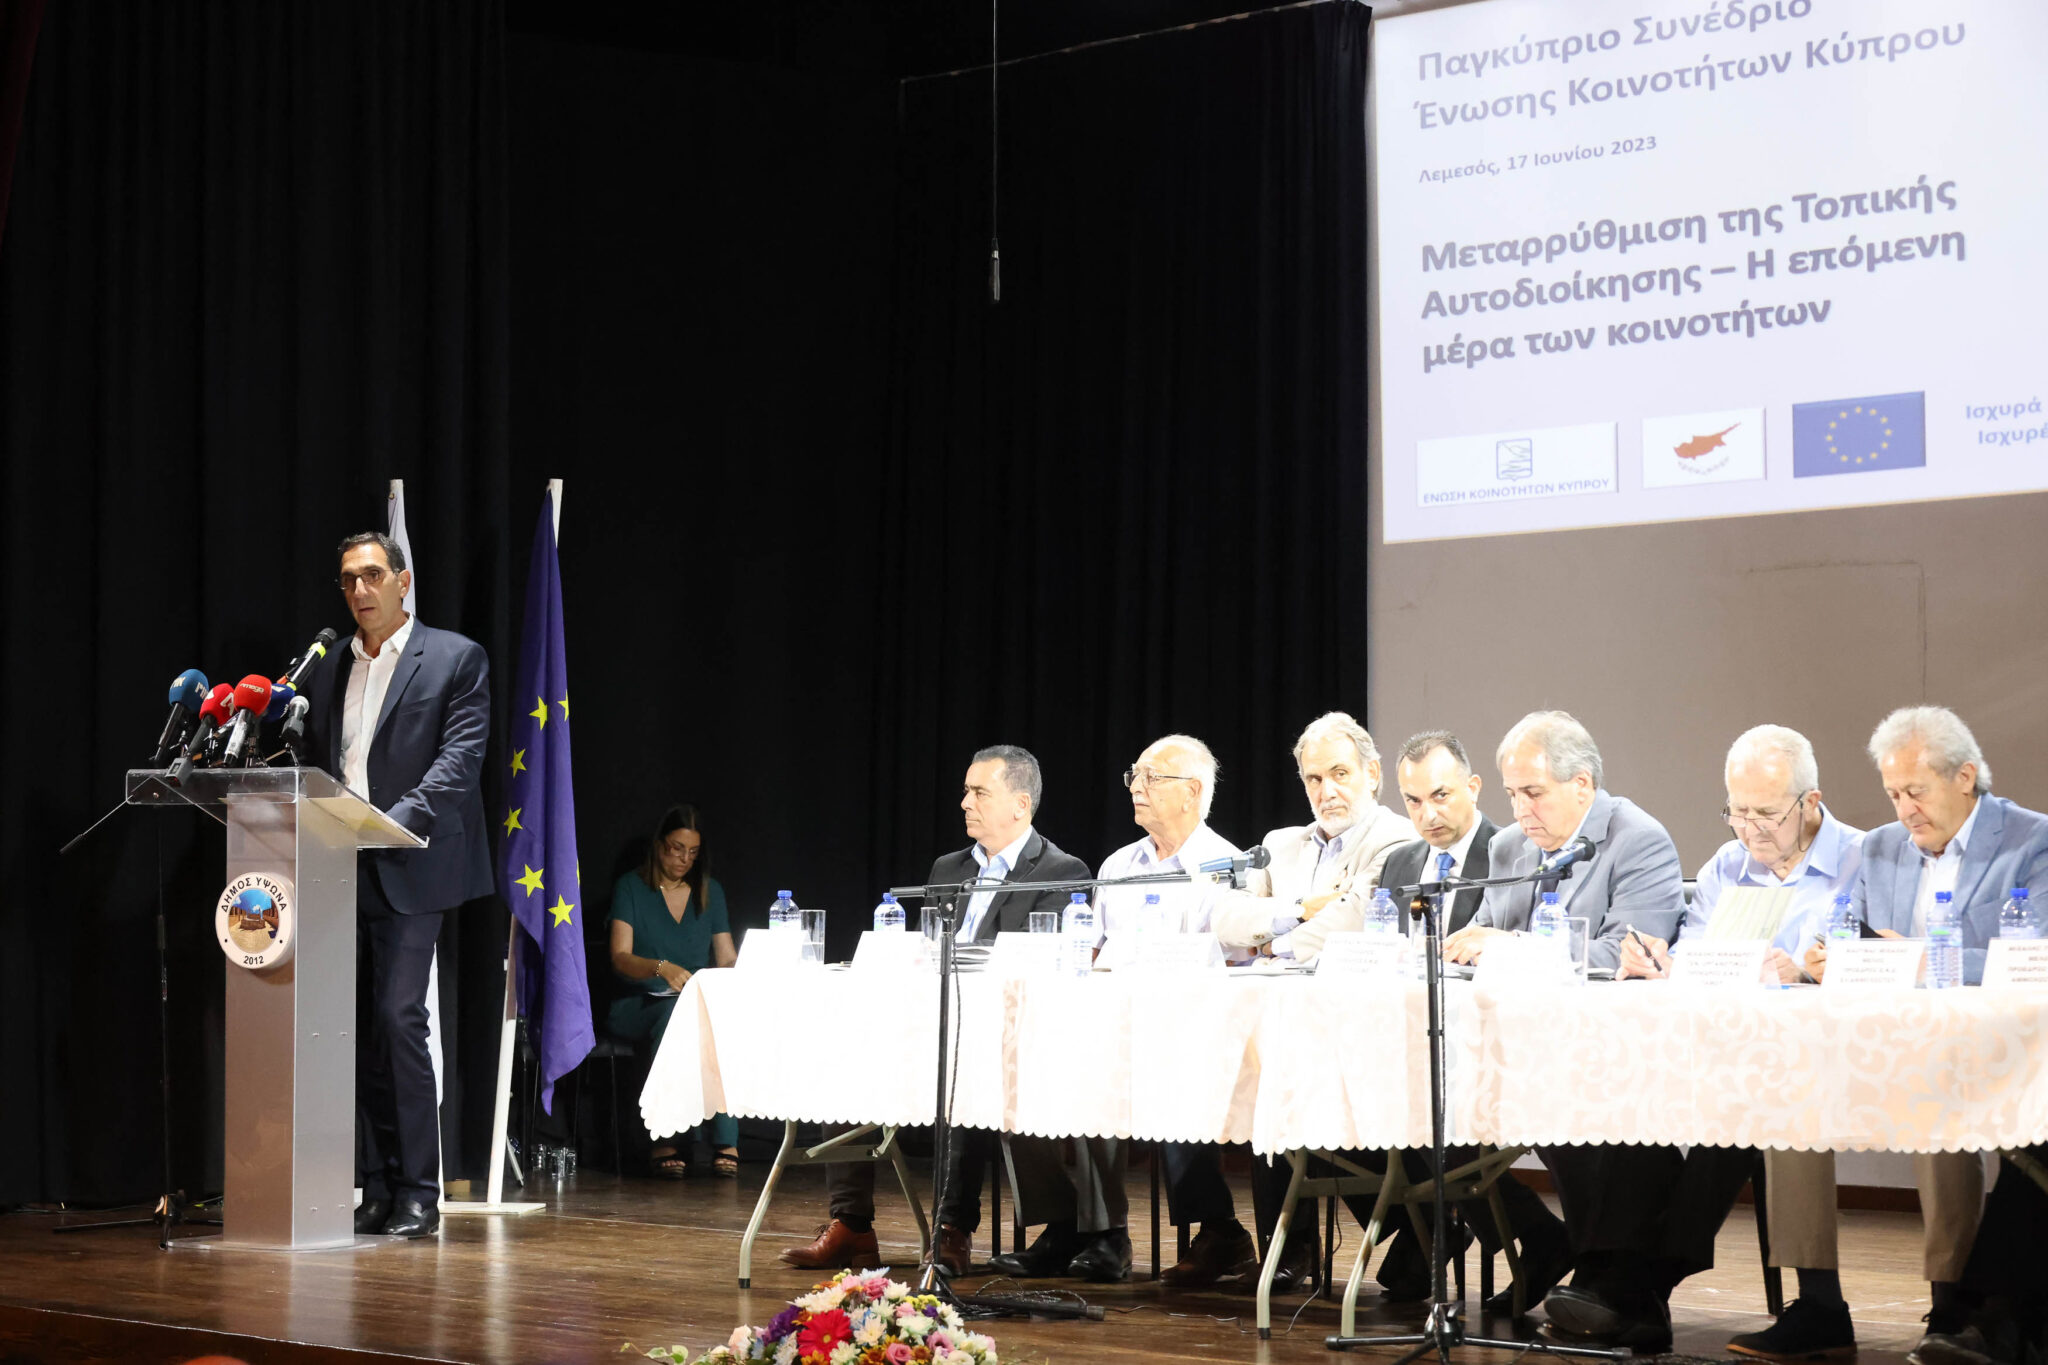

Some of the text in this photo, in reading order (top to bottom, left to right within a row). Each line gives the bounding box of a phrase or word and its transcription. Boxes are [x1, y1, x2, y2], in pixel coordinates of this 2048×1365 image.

[1418, 0, 1812, 81] Παγκύπριο Συνέδριο
[1413, 23, 1966, 129] Ένωσης Κοινοτήτων Κύπρου
[1418, 136, 1657, 183] Λεμεσός, 17 Ιουνίου 2023
[1421, 174, 1957, 272] Μεταρρύθμιση της Τοπικής
[1421, 264, 1702, 319] Αυτοδιοίκησης
[1747, 249, 1774, 280] Η
[1788, 230, 1966, 274] επόμενη
[1423, 299, 1832, 373] μέρα των κοινοτήτων
[1965, 395, 2042, 422] Ισχυρά
[1423, 478, 1610, 504] ΕΝΩΣΗ ΚΟΙΝΟΤΗΤΩΝ ΚΥΠΡΟΥ
[221, 877, 287, 912] ΔΗΜΟΣ ΥΨΩΝΑ
[243, 955, 265, 965] 2012
